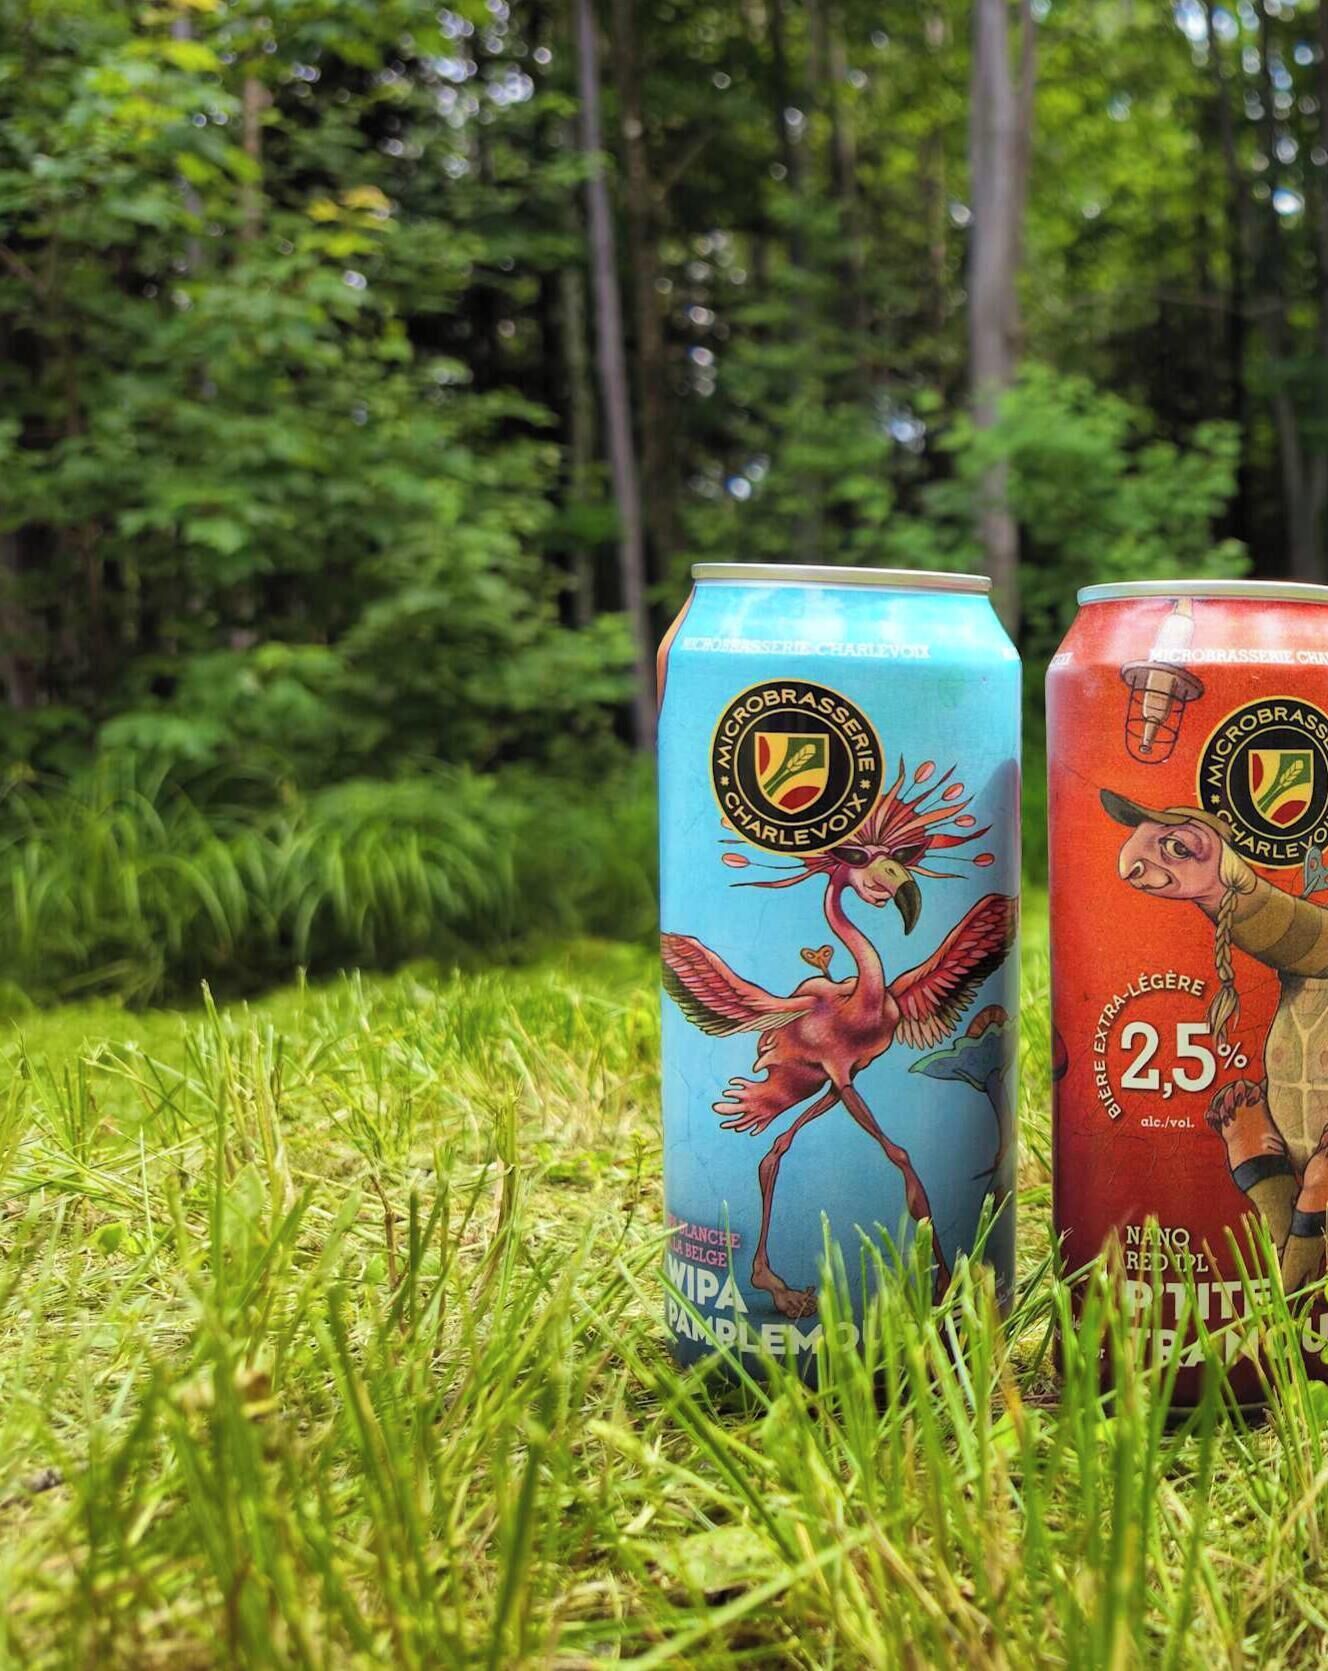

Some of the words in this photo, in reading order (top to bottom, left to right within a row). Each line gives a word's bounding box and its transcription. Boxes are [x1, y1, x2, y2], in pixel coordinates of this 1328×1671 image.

[1149, 650, 1294, 664] MICROBRASSERIE
[718, 689, 875, 772] MICROBRASSERIE
[725, 793, 867, 845] CHARLEVOIX
[1094, 970, 1205, 1053] EXTRA-LÉGÈRE
[1094, 1060, 1121, 1119] BIÈRE
[1141, 1116, 1195, 1128] alc./vol.
[685, 1243, 727, 1267] BELGE
[1126, 1226, 1190, 1247] NANO
[1126, 1251, 1169, 1271] RED
[667, 1253, 748, 1313] WIPA
